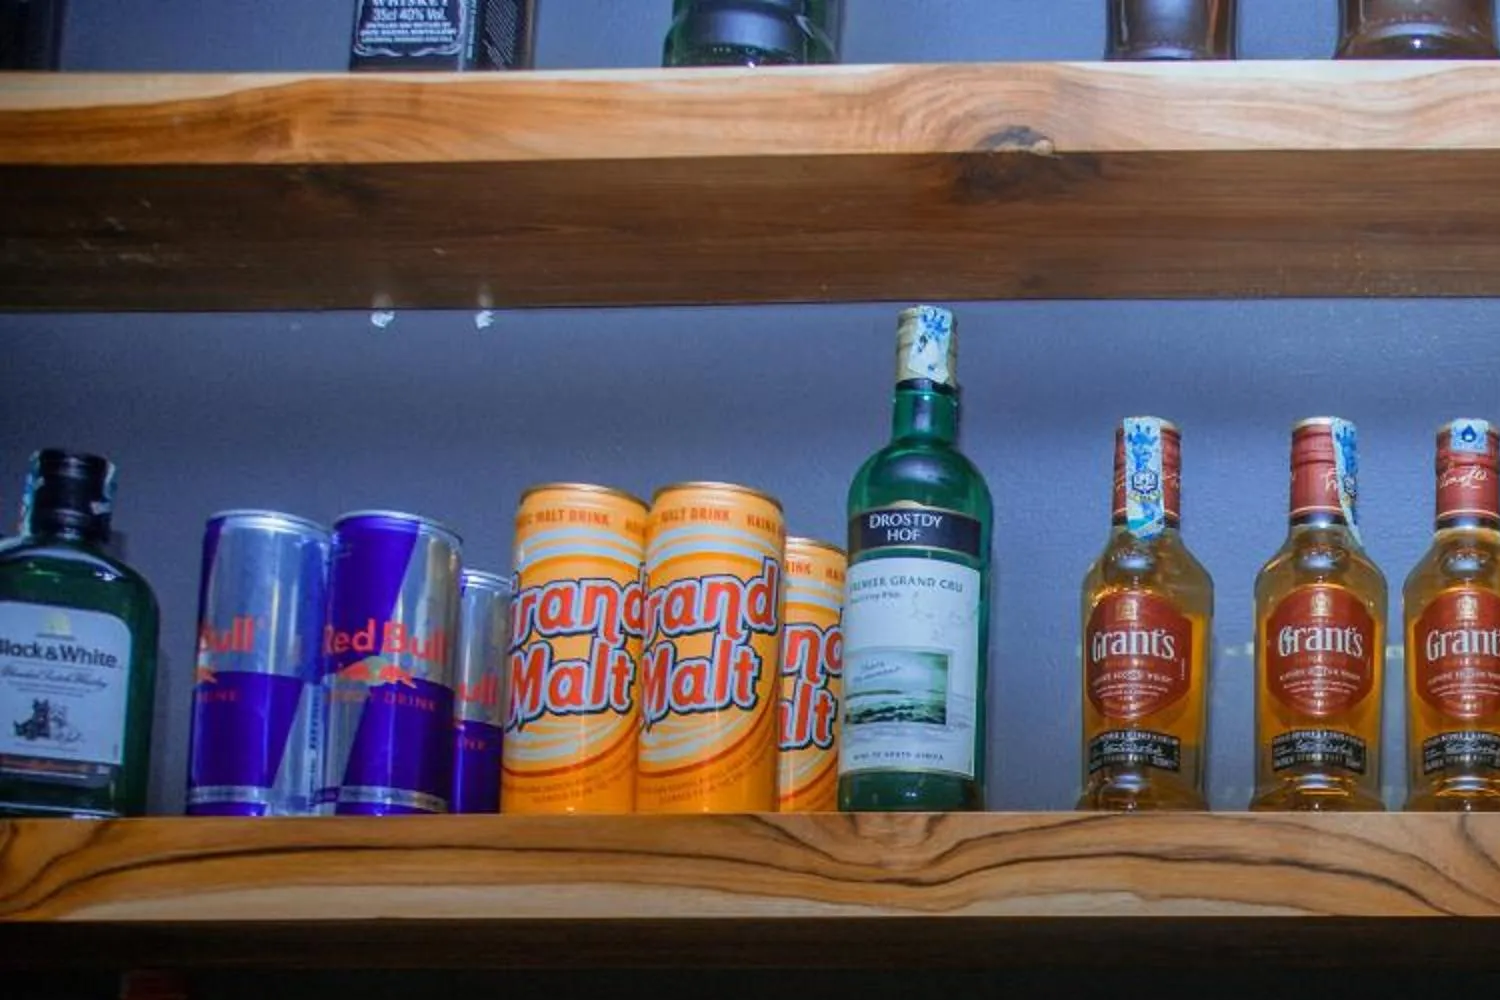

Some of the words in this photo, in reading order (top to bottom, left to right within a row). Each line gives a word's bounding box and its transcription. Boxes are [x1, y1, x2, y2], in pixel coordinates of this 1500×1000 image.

[569, 509, 611, 525] DRINK
[689, 508, 730, 522] DRINK
[868, 512, 944, 529] DROSTDY
[886, 527, 922, 542] HOF
[382, 620, 447, 664] Bull
[1091, 627, 1176, 664] Grant's
[1278, 625, 1363, 658] Grant's
[504, 640, 630, 729] Malt
